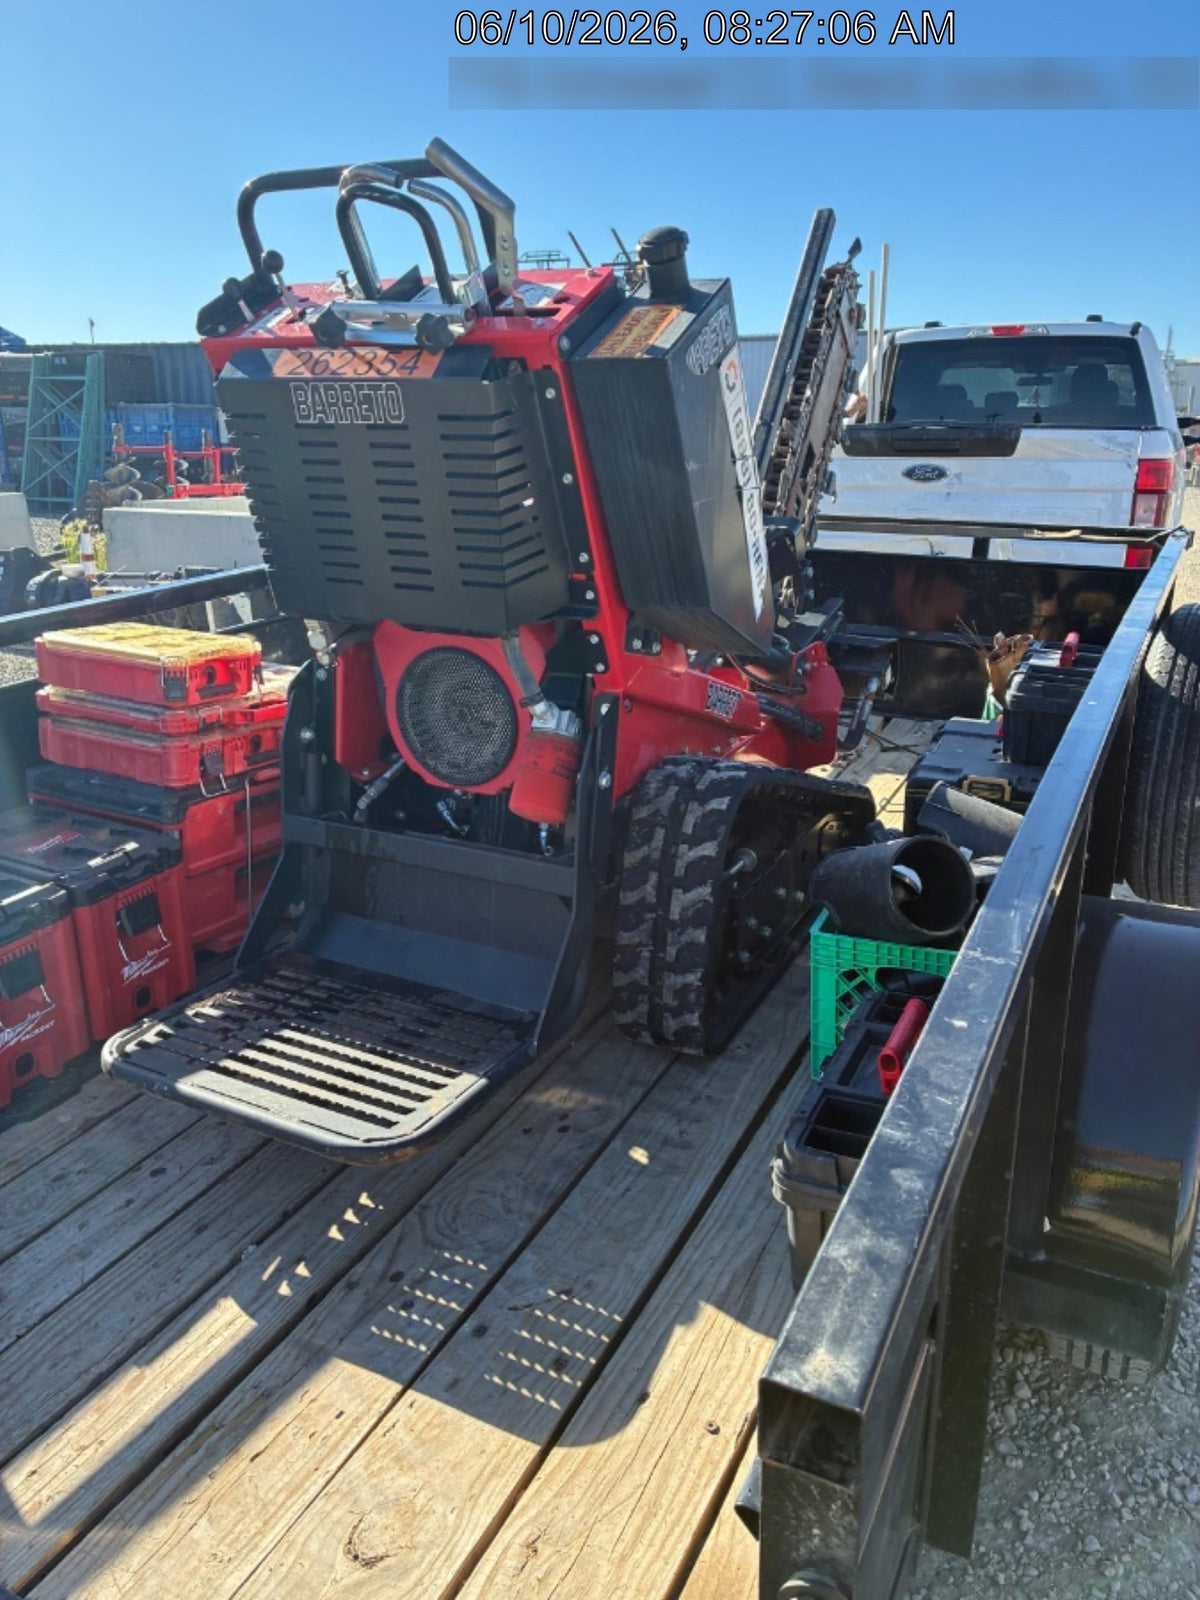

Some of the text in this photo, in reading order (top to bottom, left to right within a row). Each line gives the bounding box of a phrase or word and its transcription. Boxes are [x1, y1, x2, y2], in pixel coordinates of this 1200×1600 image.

[286, 350, 425, 377] 262354
[290, 381, 405, 424] BARRETO
[705, 680, 745, 719] BARRETO
